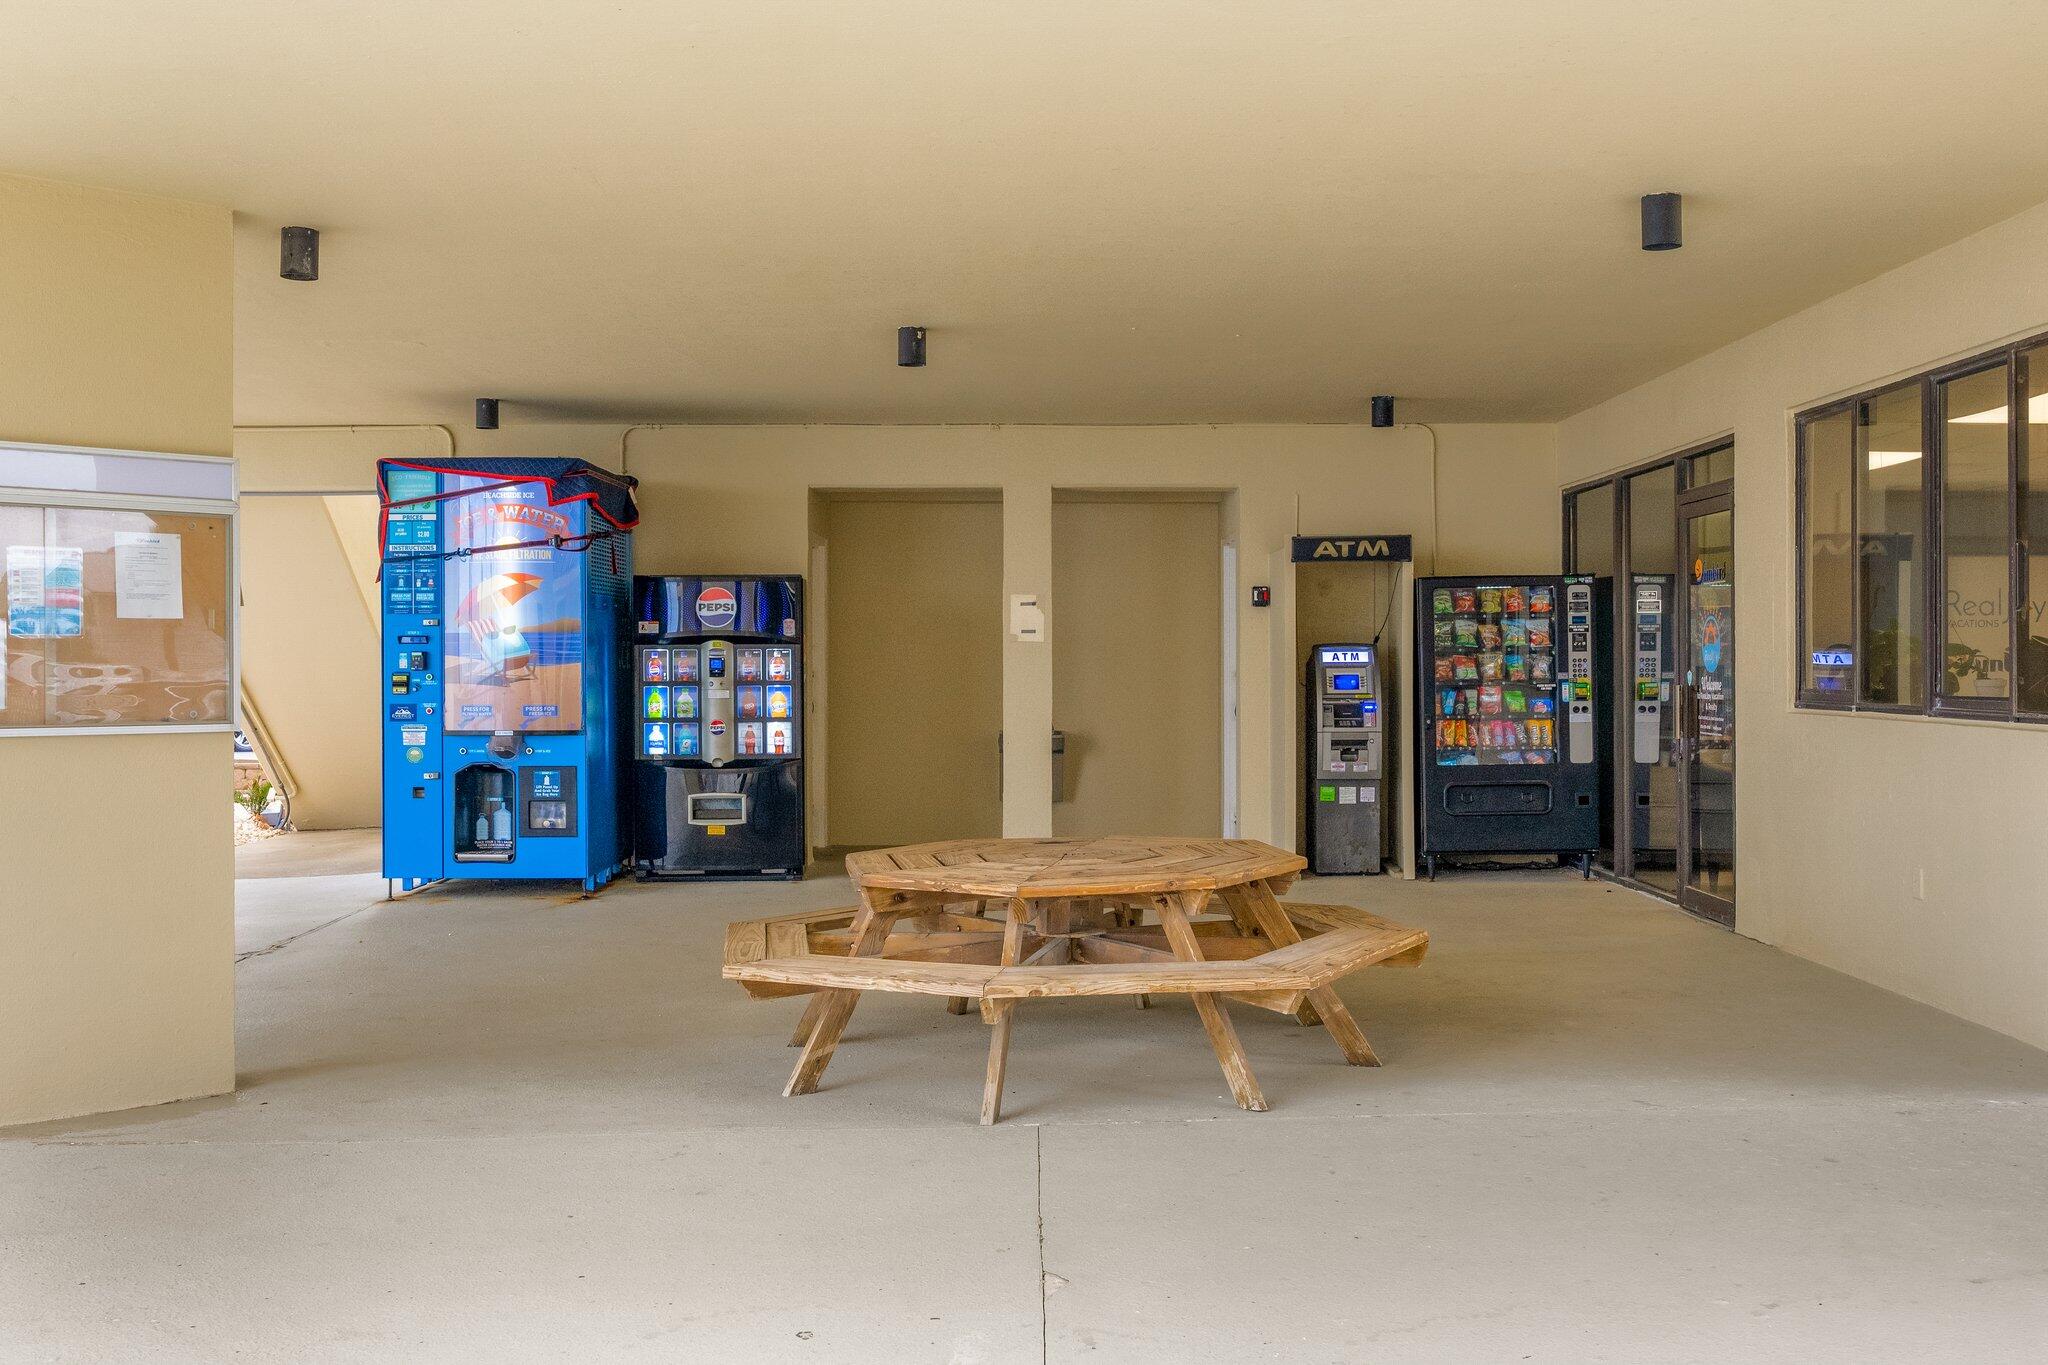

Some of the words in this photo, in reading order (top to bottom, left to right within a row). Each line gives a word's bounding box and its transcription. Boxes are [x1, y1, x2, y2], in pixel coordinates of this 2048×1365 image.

[523, 491, 535, 499] ICE
[503, 504, 565, 530] WATER
[1313, 540, 1390, 558] ATM
[698, 602, 735, 612] PEPSI
[1945, 587, 2047, 624] Realy
[1948, 619, 2000, 628] VACATIONS
[1332, 652, 1360, 661] ATM
